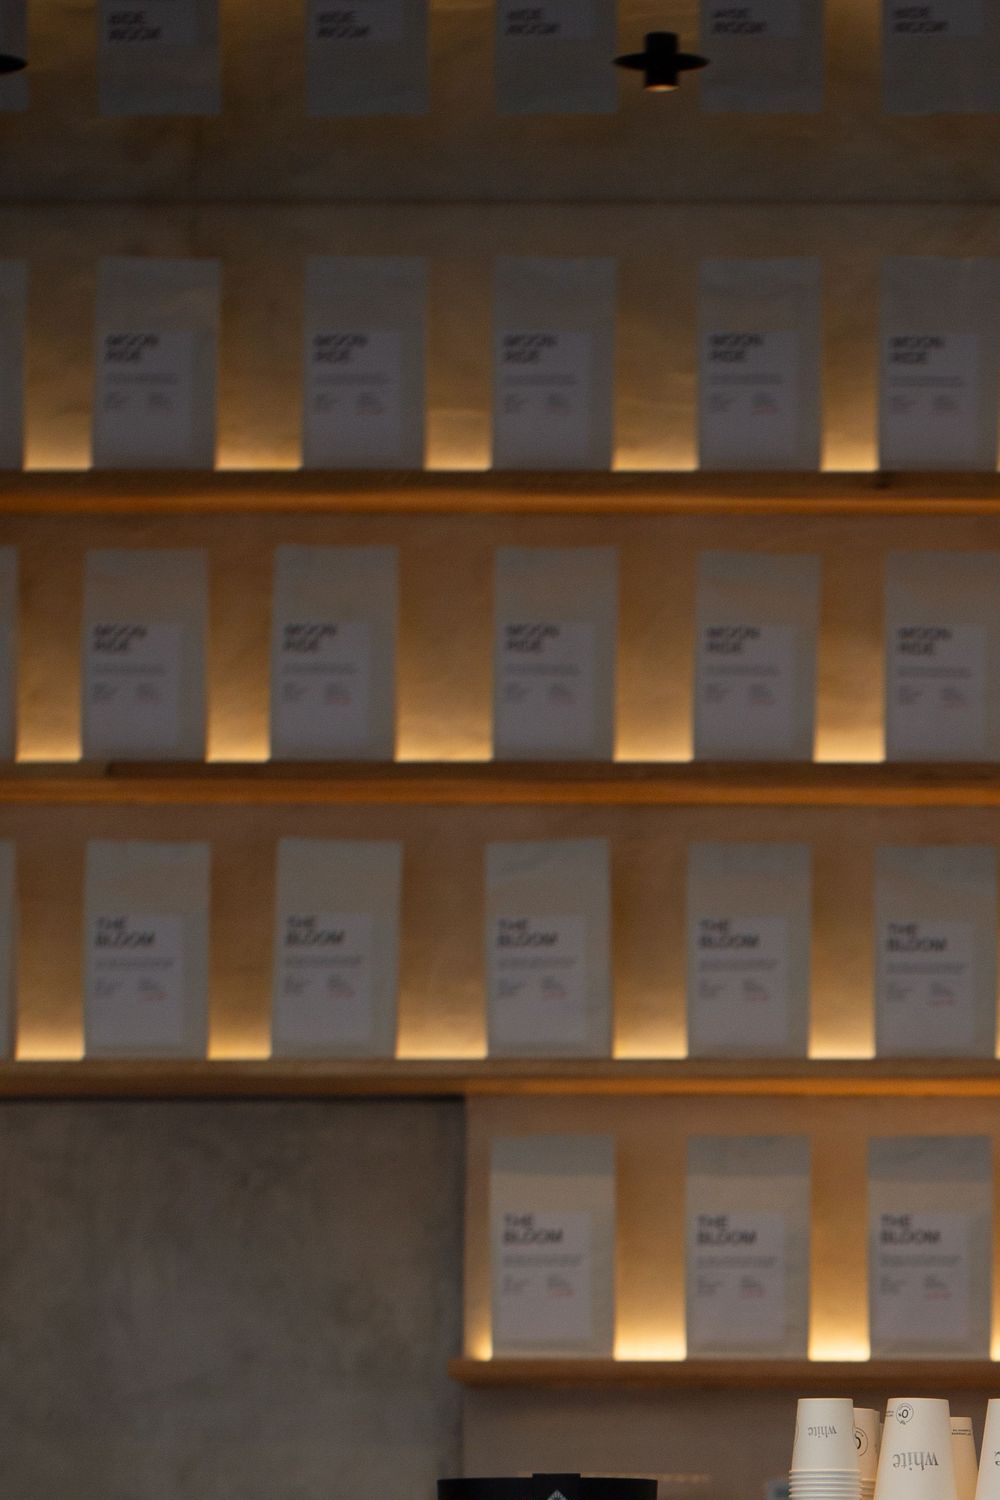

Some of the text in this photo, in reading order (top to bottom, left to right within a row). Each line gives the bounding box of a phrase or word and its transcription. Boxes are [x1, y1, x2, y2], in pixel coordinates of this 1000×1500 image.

[502, 1228, 564, 1245] BLOOM
[696, 1229, 758, 1246] BLOOM
[879, 1229, 941, 1245] BLOOM
[807, 1424, 838, 1439] white
[893, 1450, 940, 1471] white
